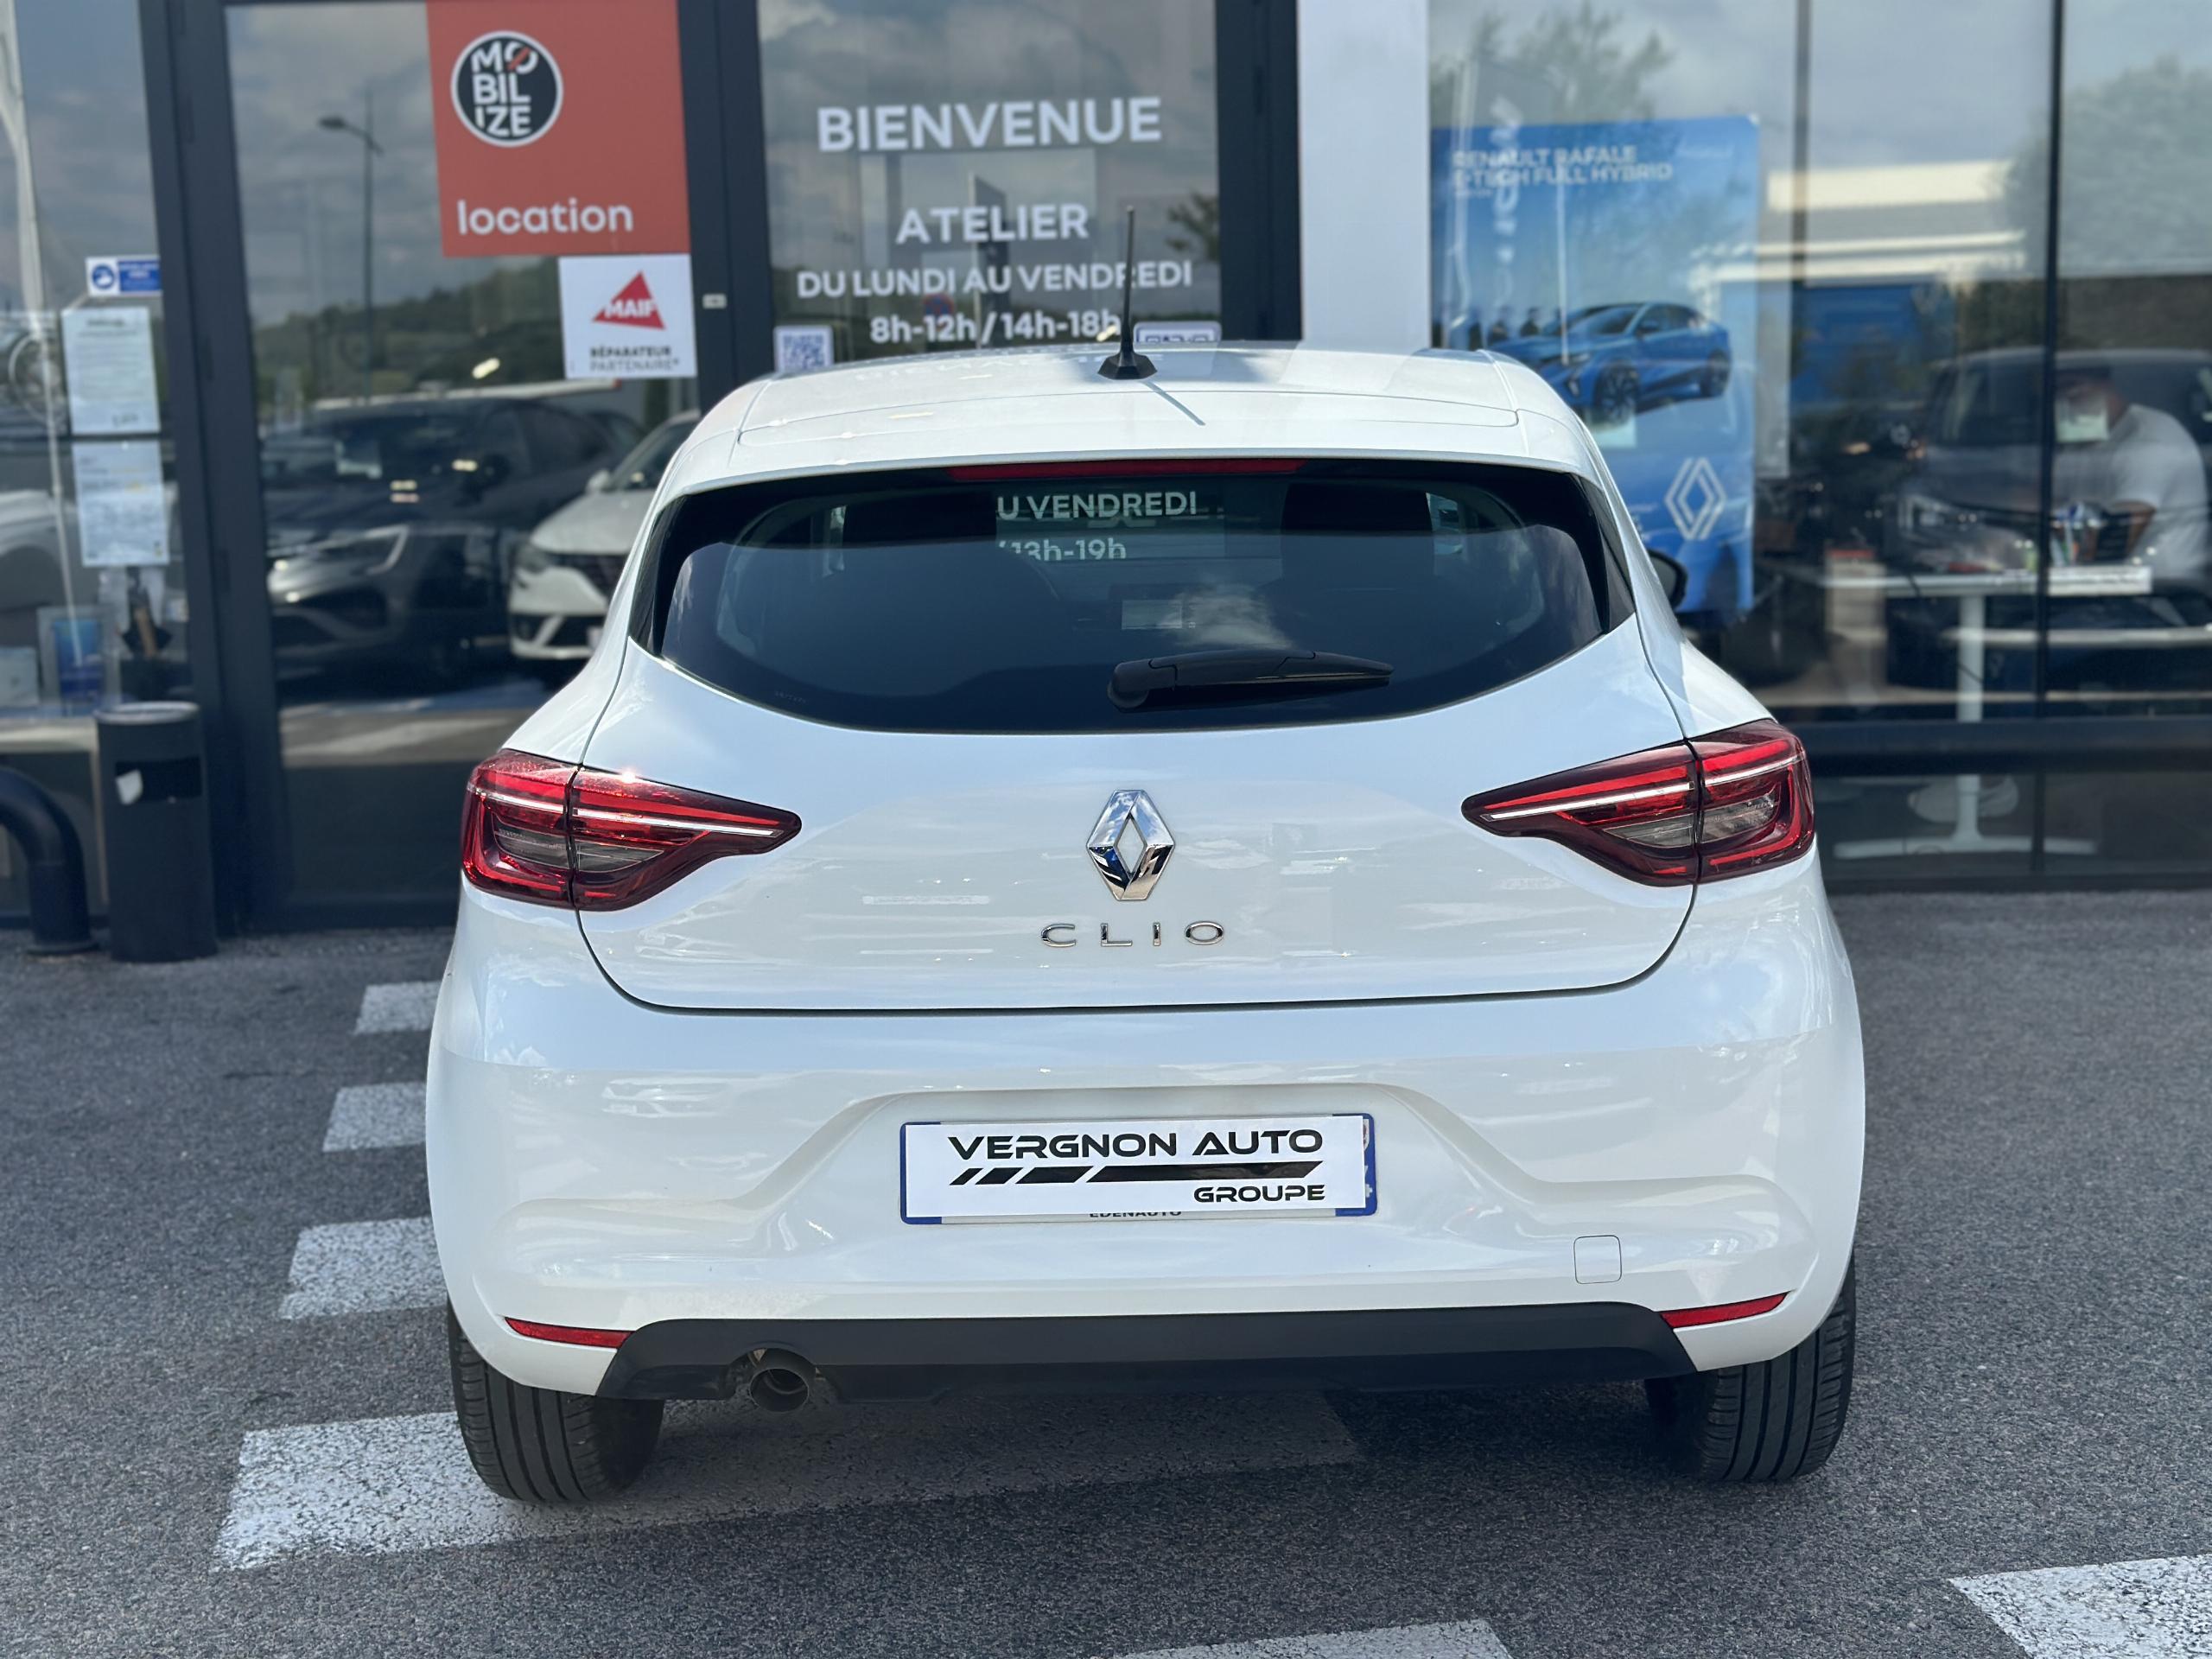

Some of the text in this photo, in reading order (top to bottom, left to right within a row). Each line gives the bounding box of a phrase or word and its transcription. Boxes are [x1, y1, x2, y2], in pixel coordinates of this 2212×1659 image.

[817, 97, 1162, 152] BIENVENUE
[456, 197, 634, 235] location
[895, 204, 1090, 245] ATELIER
[797, 260, 1192, 298] DU LUNDI AU VENDREDI
[604, 299, 656, 320] MAIF
[1026, 491, 1197, 519] VENDREDI
[1040, 920, 1224, 948] CLIO
[948, 1128, 1324, 1160] VERGNON AUTO
[1194, 1184, 1325, 1204] GROUPE
